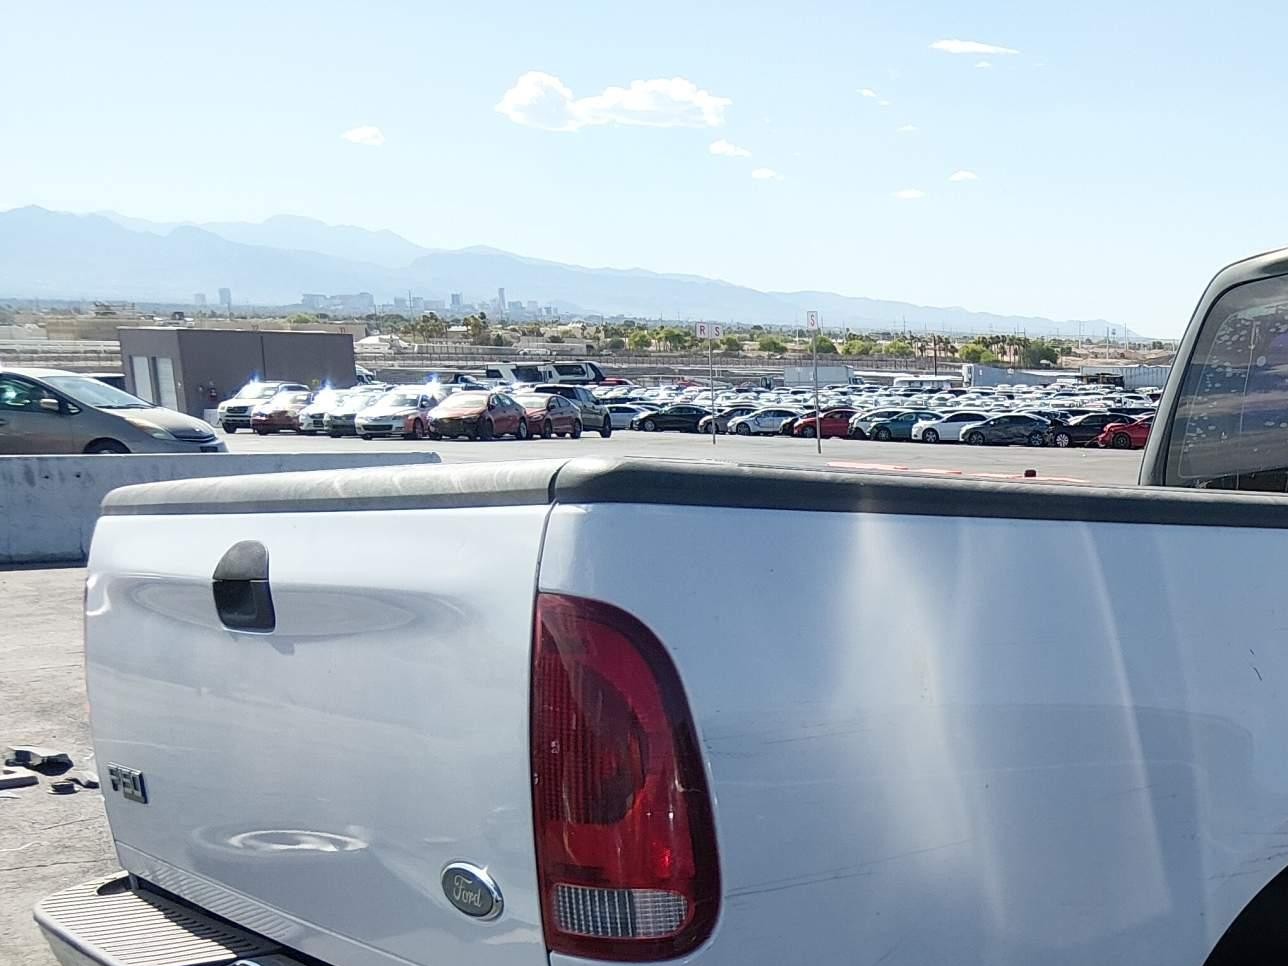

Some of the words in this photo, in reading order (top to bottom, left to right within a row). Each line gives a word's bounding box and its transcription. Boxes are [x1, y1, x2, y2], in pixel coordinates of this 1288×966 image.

[700, 325, 706, 336] R
[714, 326, 720, 337] S
[453, 874, 481, 908] Ford
